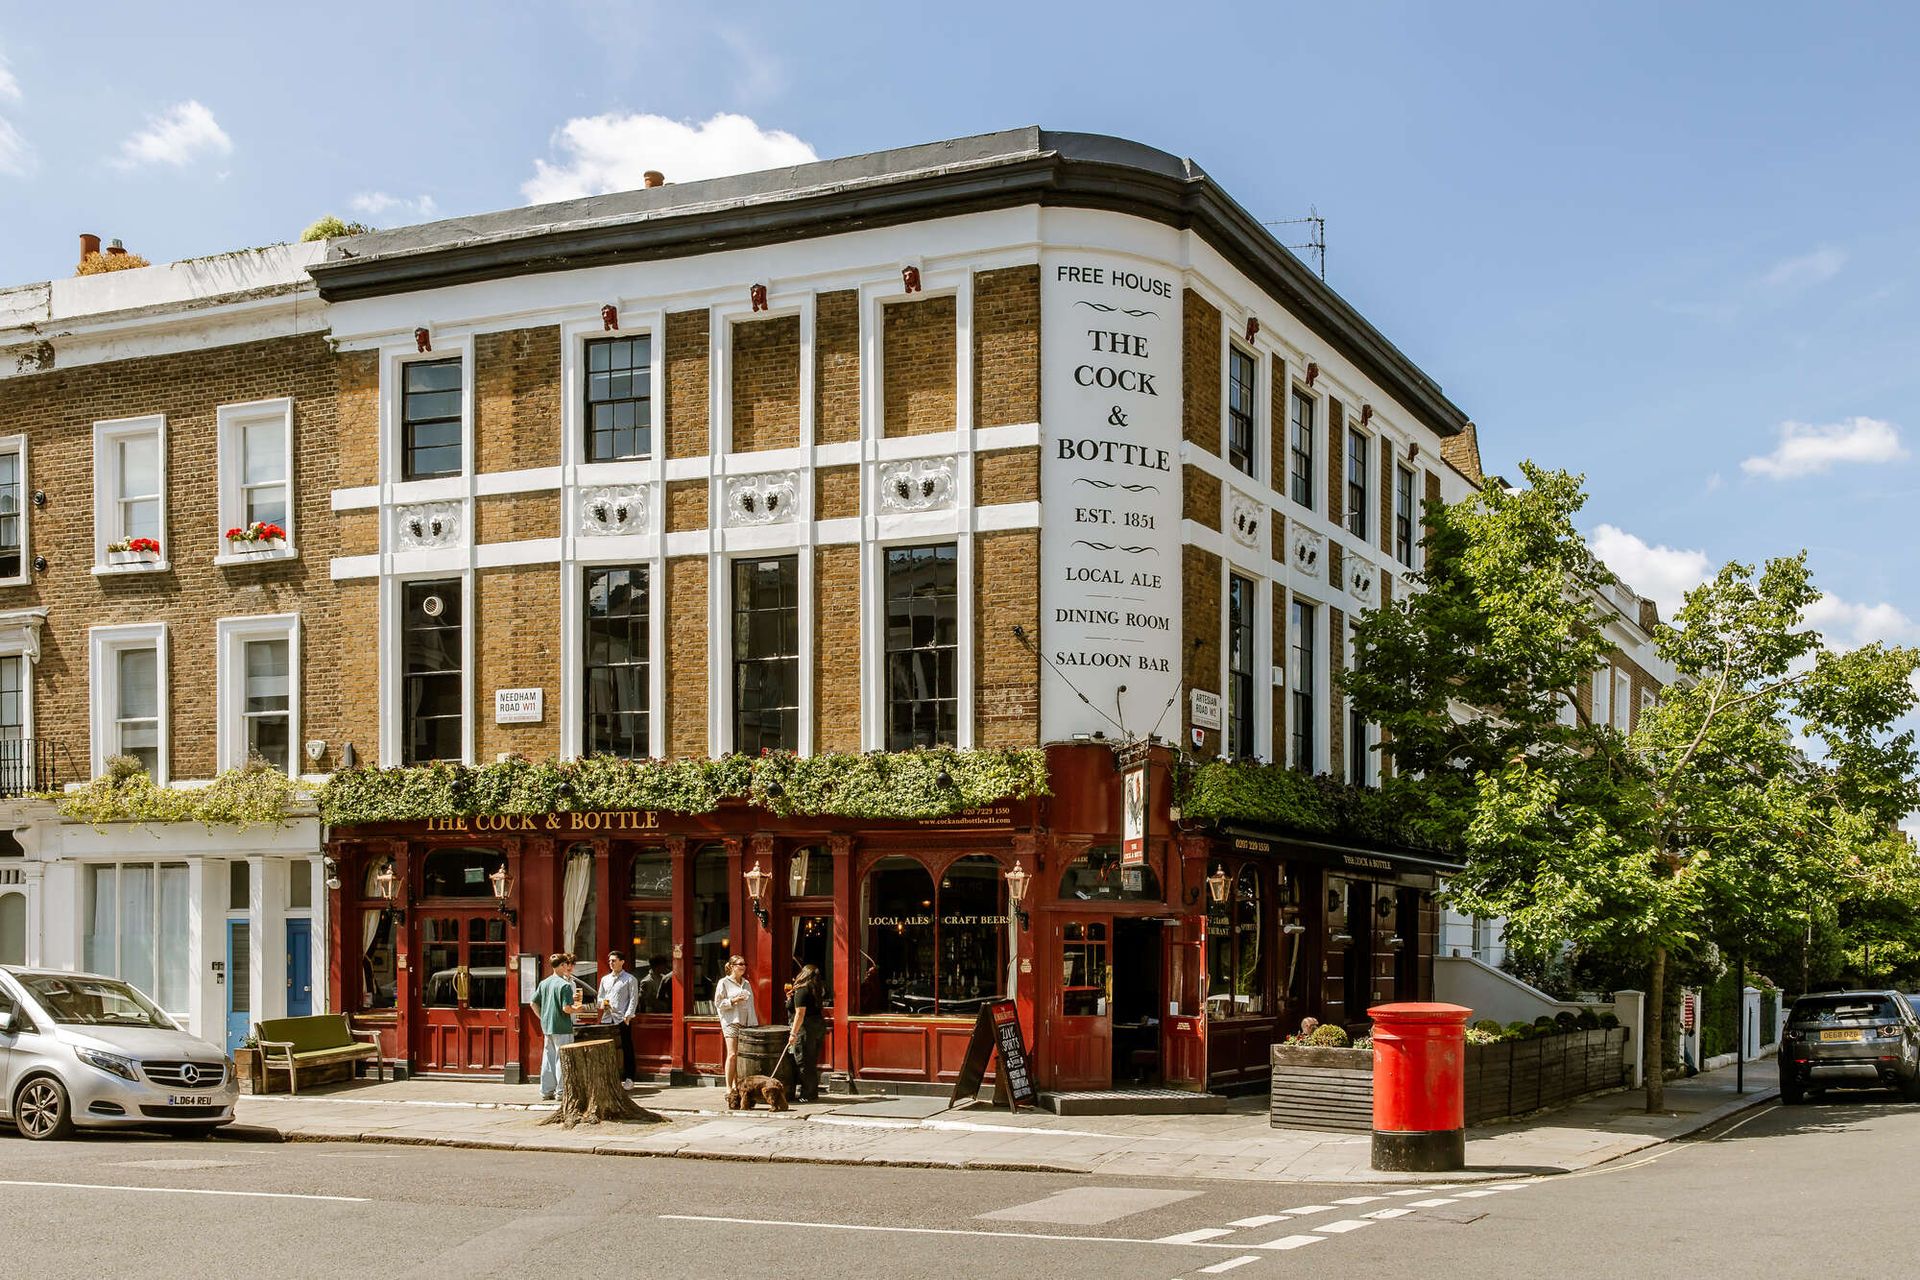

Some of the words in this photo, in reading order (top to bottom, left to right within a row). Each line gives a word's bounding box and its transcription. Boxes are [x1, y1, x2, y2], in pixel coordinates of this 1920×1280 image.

[1057, 266, 1104, 284] FREE
[1112, 271, 1172, 299] HOUSE
[1087, 330, 1149, 358] THE
[1074, 364, 1159, 396] COCK
[1108, 405, 1128, 427] &
[1057, 438, 1171, 472] BOTTLE
[1074, 507, 1116, 525] EST.
[1124, 512, 1155, 530] 1851
[1065, 567, 1124, 584] LOCAL
[1131, 572, 1162, 589] ALE
[1055, 608, 1119, 625] DINING
[1126, 612, 1170, 631] ROOM
[1055, 651, 1131, 668] SALOON
[1138, 656, 1170, 672] BAR
[500, 692, 537, 702] NEEDHAM
[500, 702, 520, 712] ROAD
[523, 702, 536, 711] W11
[476, 812, 537, 831] COCK
[545, 812, 561, 830] &
[570, 811, 660, 830] BOTTLE
[868, 917, 899, 925] LOCAL
[904, 916, 929, 925] ALES
[944, 916, 978, 925] CRAFT
[981, 915, 1011, 925] BEERS
[174, 1095, 195, 1105] LD64
[197, 1096, 212, 1105] REU
